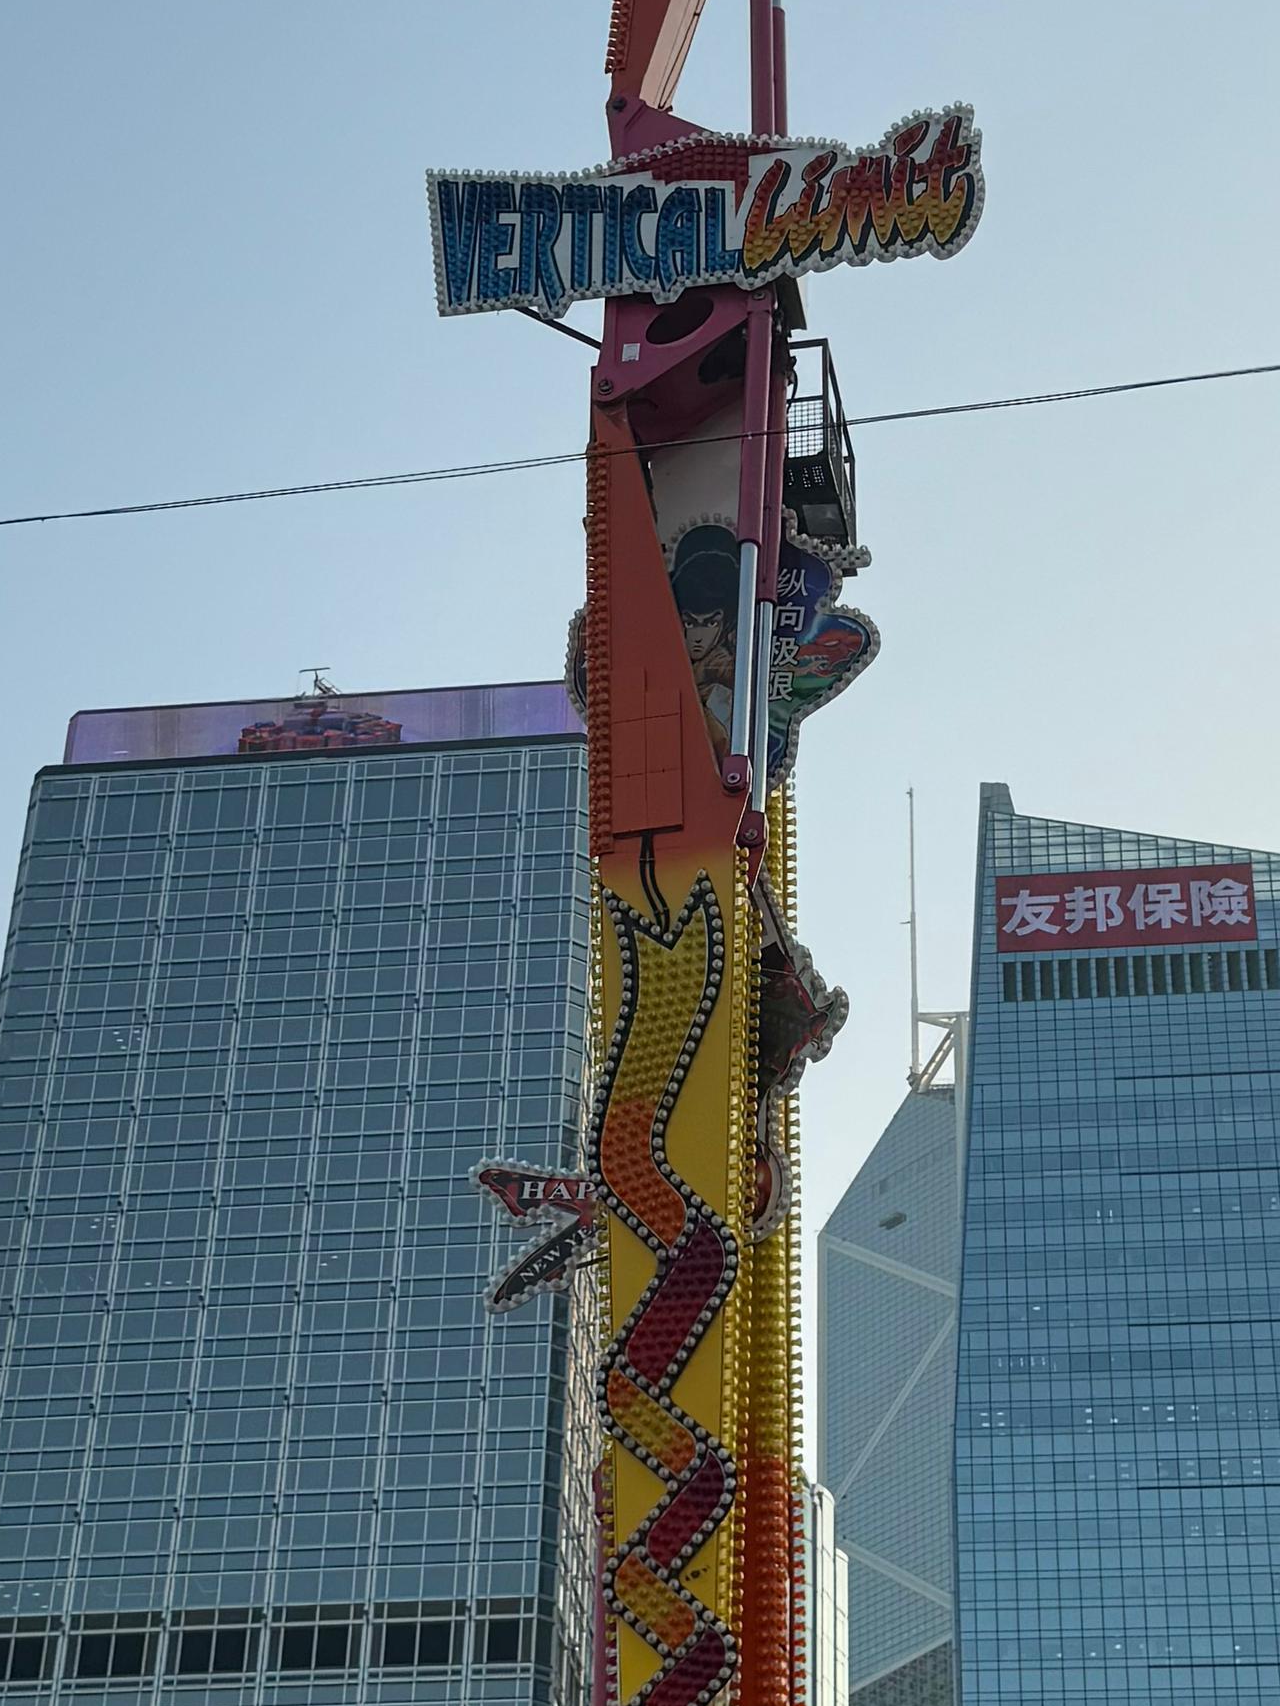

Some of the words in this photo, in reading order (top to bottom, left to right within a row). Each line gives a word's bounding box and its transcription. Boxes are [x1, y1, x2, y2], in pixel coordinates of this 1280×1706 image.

[437, 180, 746, 306] VERTICAL
[742, 115, 974, 271] Limit
[1001, 877, 1254, 936] 友邦保險
[521, 1181, 596, 1200] HAP
[520, 1245, 562, 1282] NEW
